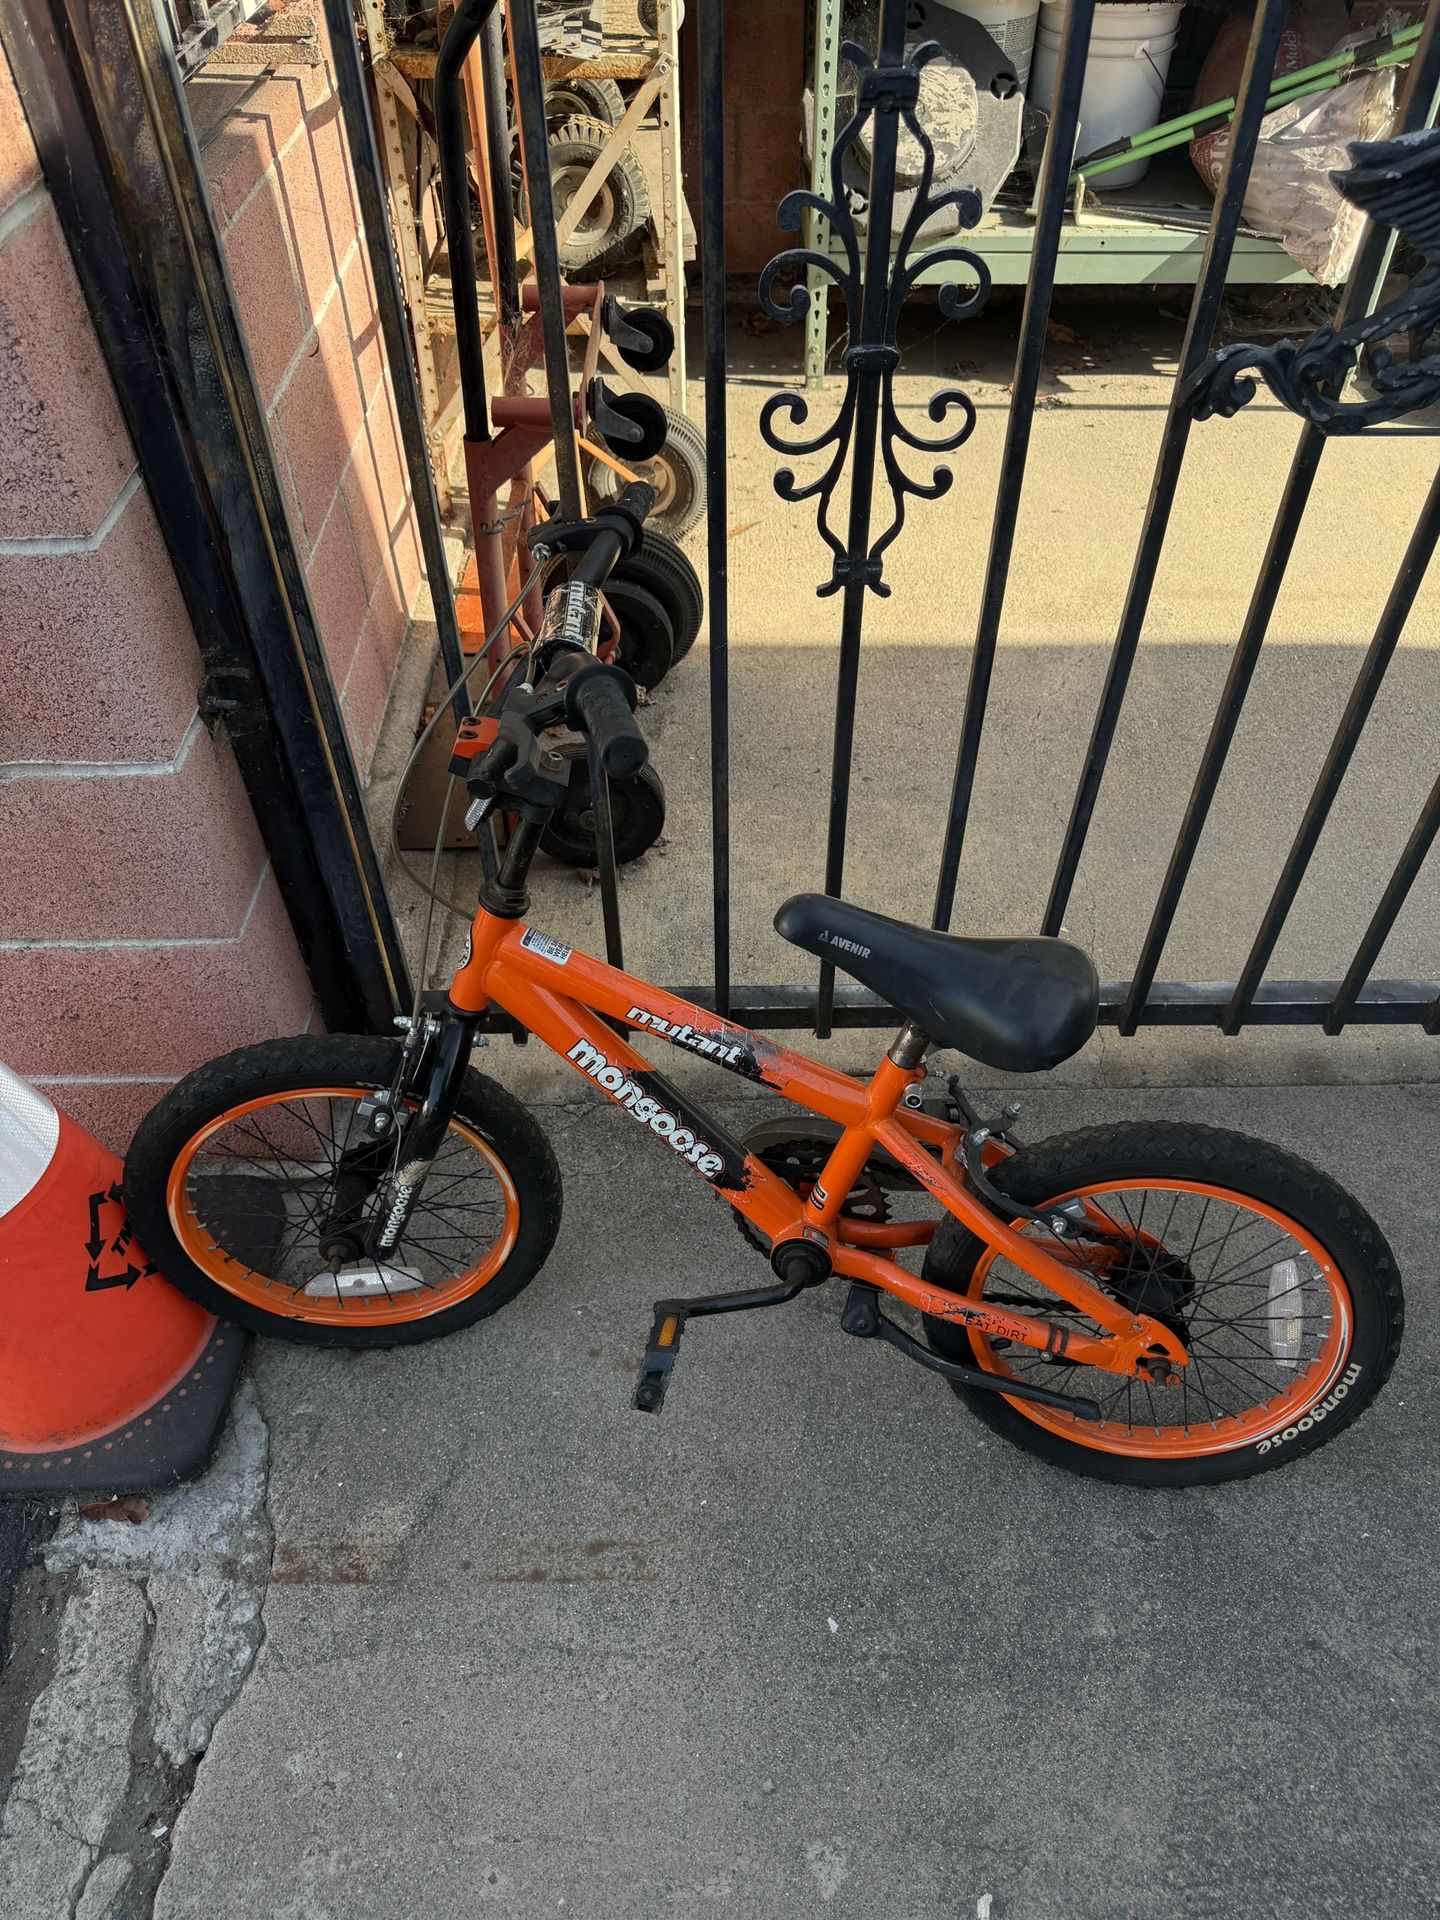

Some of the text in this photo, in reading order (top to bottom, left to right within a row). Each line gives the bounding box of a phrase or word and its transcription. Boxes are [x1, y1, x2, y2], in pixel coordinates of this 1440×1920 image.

[1284, 30, 1298, 70] Mulch
[830, 935, 871, 959] AVENIR
[625, 1006, 742, 1064] mutant
[566, 1038, 724, 1178] mongoose
[380, 1185, 413, 1247] mongoose
[964, 1318, 1029, 1342] EAT DIRT
[1256, 1362, 1363, 1455] mongoose
